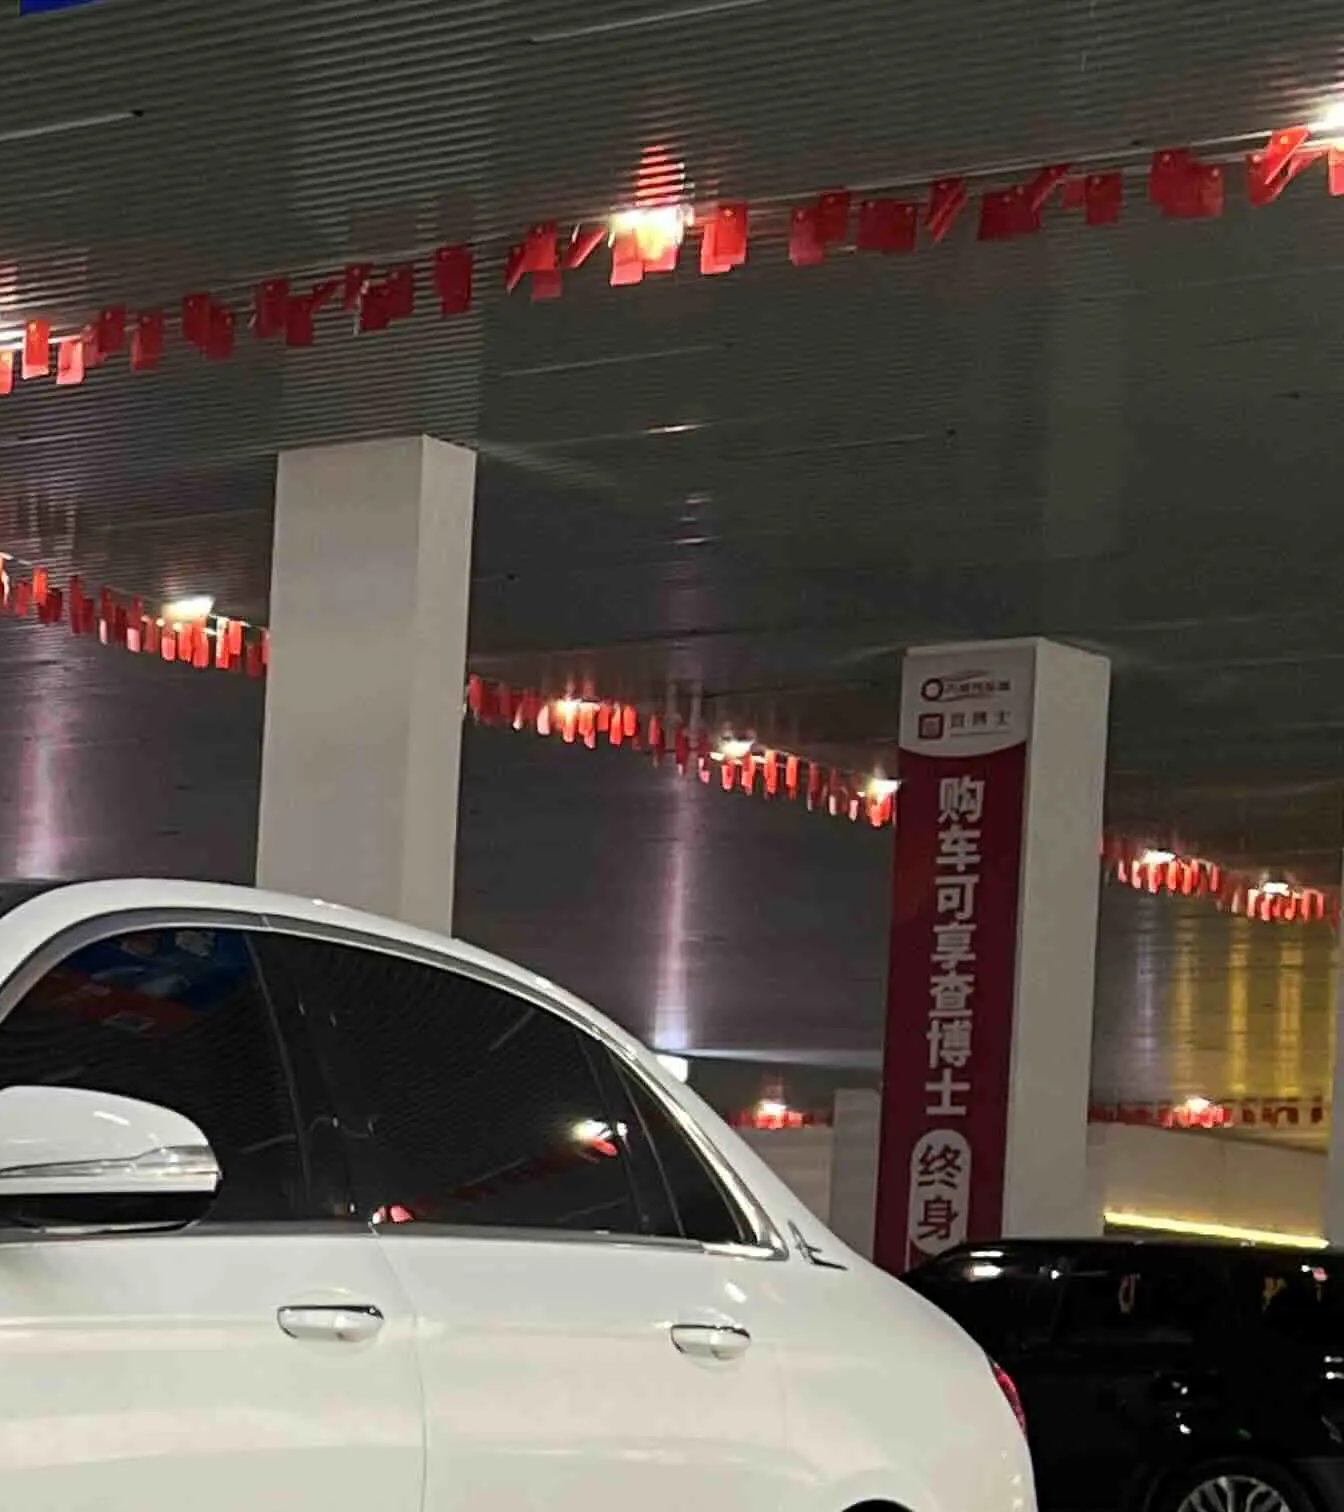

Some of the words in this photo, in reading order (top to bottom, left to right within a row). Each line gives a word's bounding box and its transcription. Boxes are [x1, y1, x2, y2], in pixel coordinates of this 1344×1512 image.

[925, 776, 985, 1116] 购车可享查博士
[917, 1145, 962, 1241] 终身
